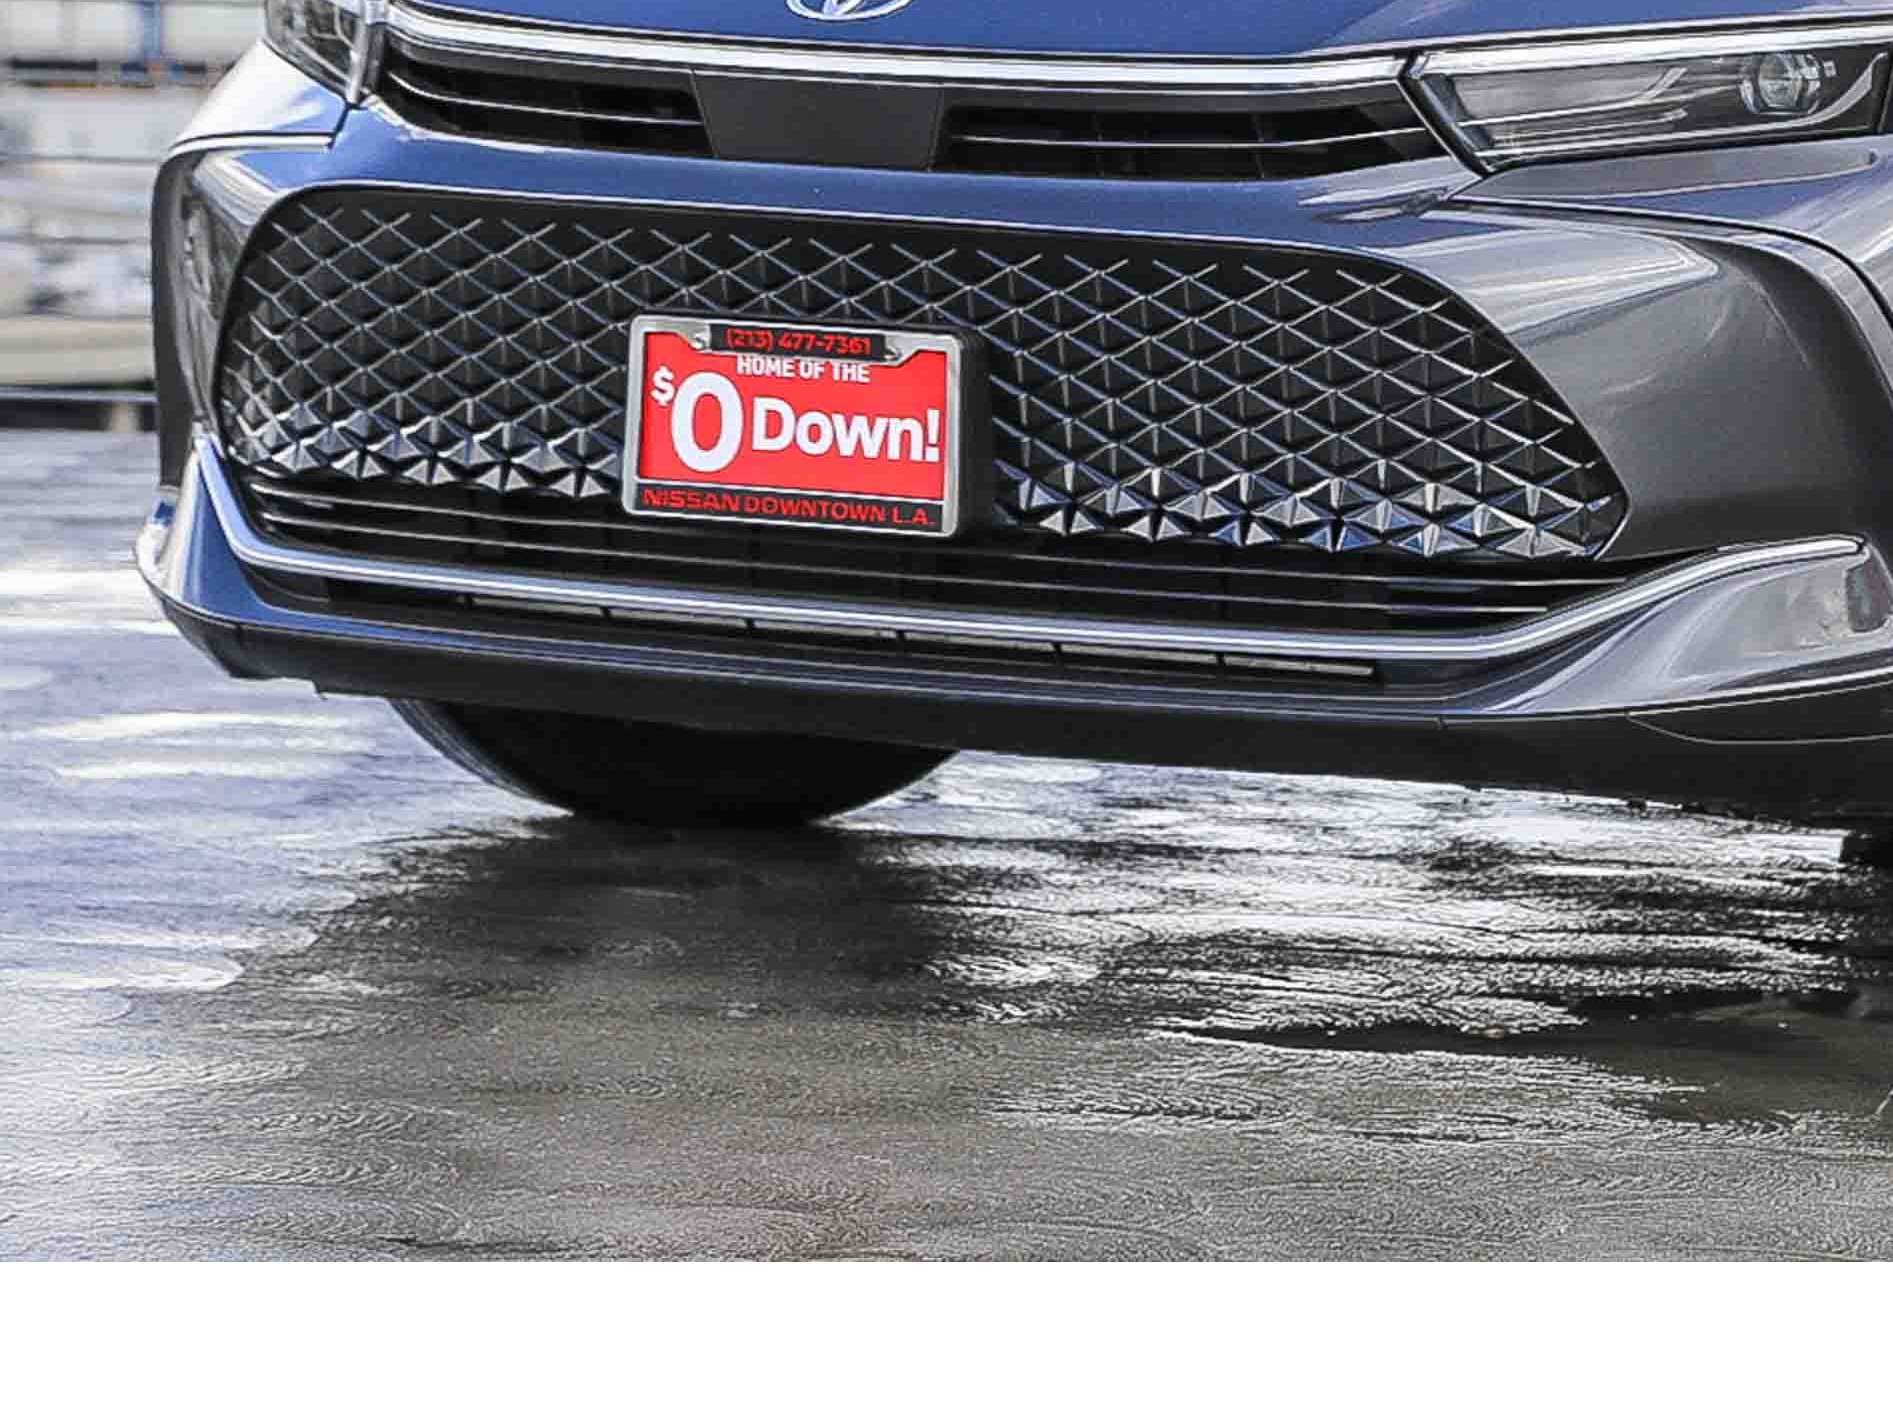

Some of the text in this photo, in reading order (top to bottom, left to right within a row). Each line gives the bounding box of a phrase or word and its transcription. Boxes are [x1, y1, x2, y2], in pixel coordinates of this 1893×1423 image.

[778, 331, 872, 355] 477-7361
[736, 354, 872, 383] HOME OF THE
[650, 365, 941, 473] $0 Down!
[642, 488, 936, 526] NISSAN DOWNTOWN L.A.
